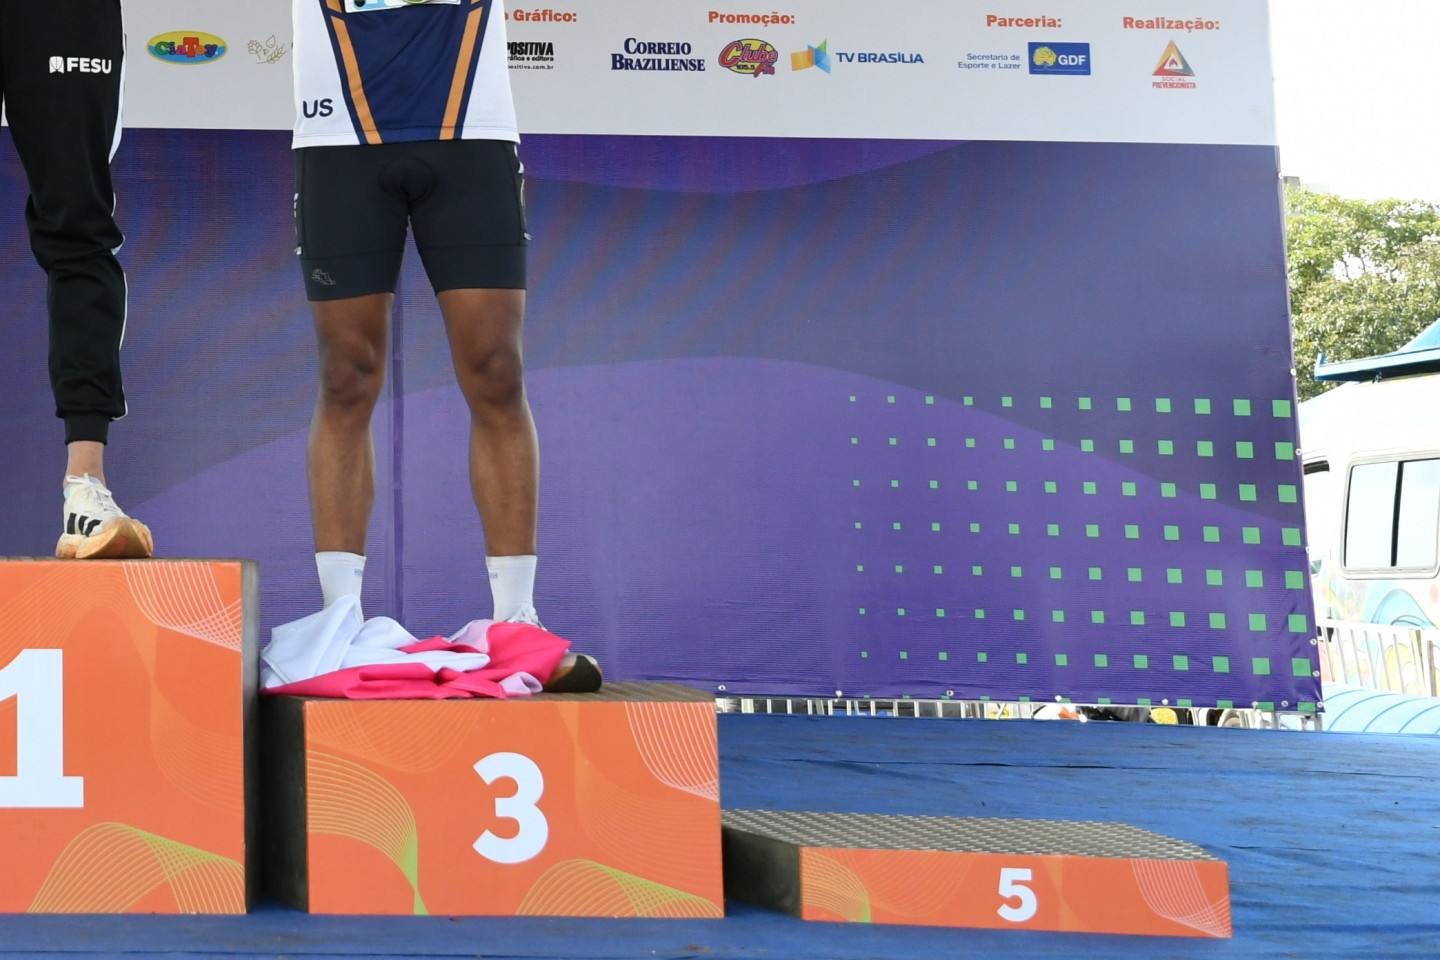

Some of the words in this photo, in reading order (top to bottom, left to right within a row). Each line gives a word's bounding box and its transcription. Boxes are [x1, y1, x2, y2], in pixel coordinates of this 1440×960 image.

[513, 9, 577, 23] Gráfico:
[708, 11, 795, 27] Promoção:
[986, 14, 1062, 28] Parceria:
[1123, 16, 1220, 32] Realização:
[624, 38, 692, 55] CORREIO
[611, 53, 705, 71] BRAZILIENSE
[835, 52, 855, 63] TV
[857, 51, 925, 64] BRASÍLIA
[966, 52, 1008, 61] Secretaria
[1010, 53, 1021, 61] de
[1058, 54, 1087, 66] GDF
[67, 57, 112, 74] FESU
[957, 61, 989, 70] Esporte
[998, 62, 1021, 70] Lazer
[302, 98, 334, 119] US
[473, 753, 549, 865] 3
[998, 868, 1037, 922] 5
